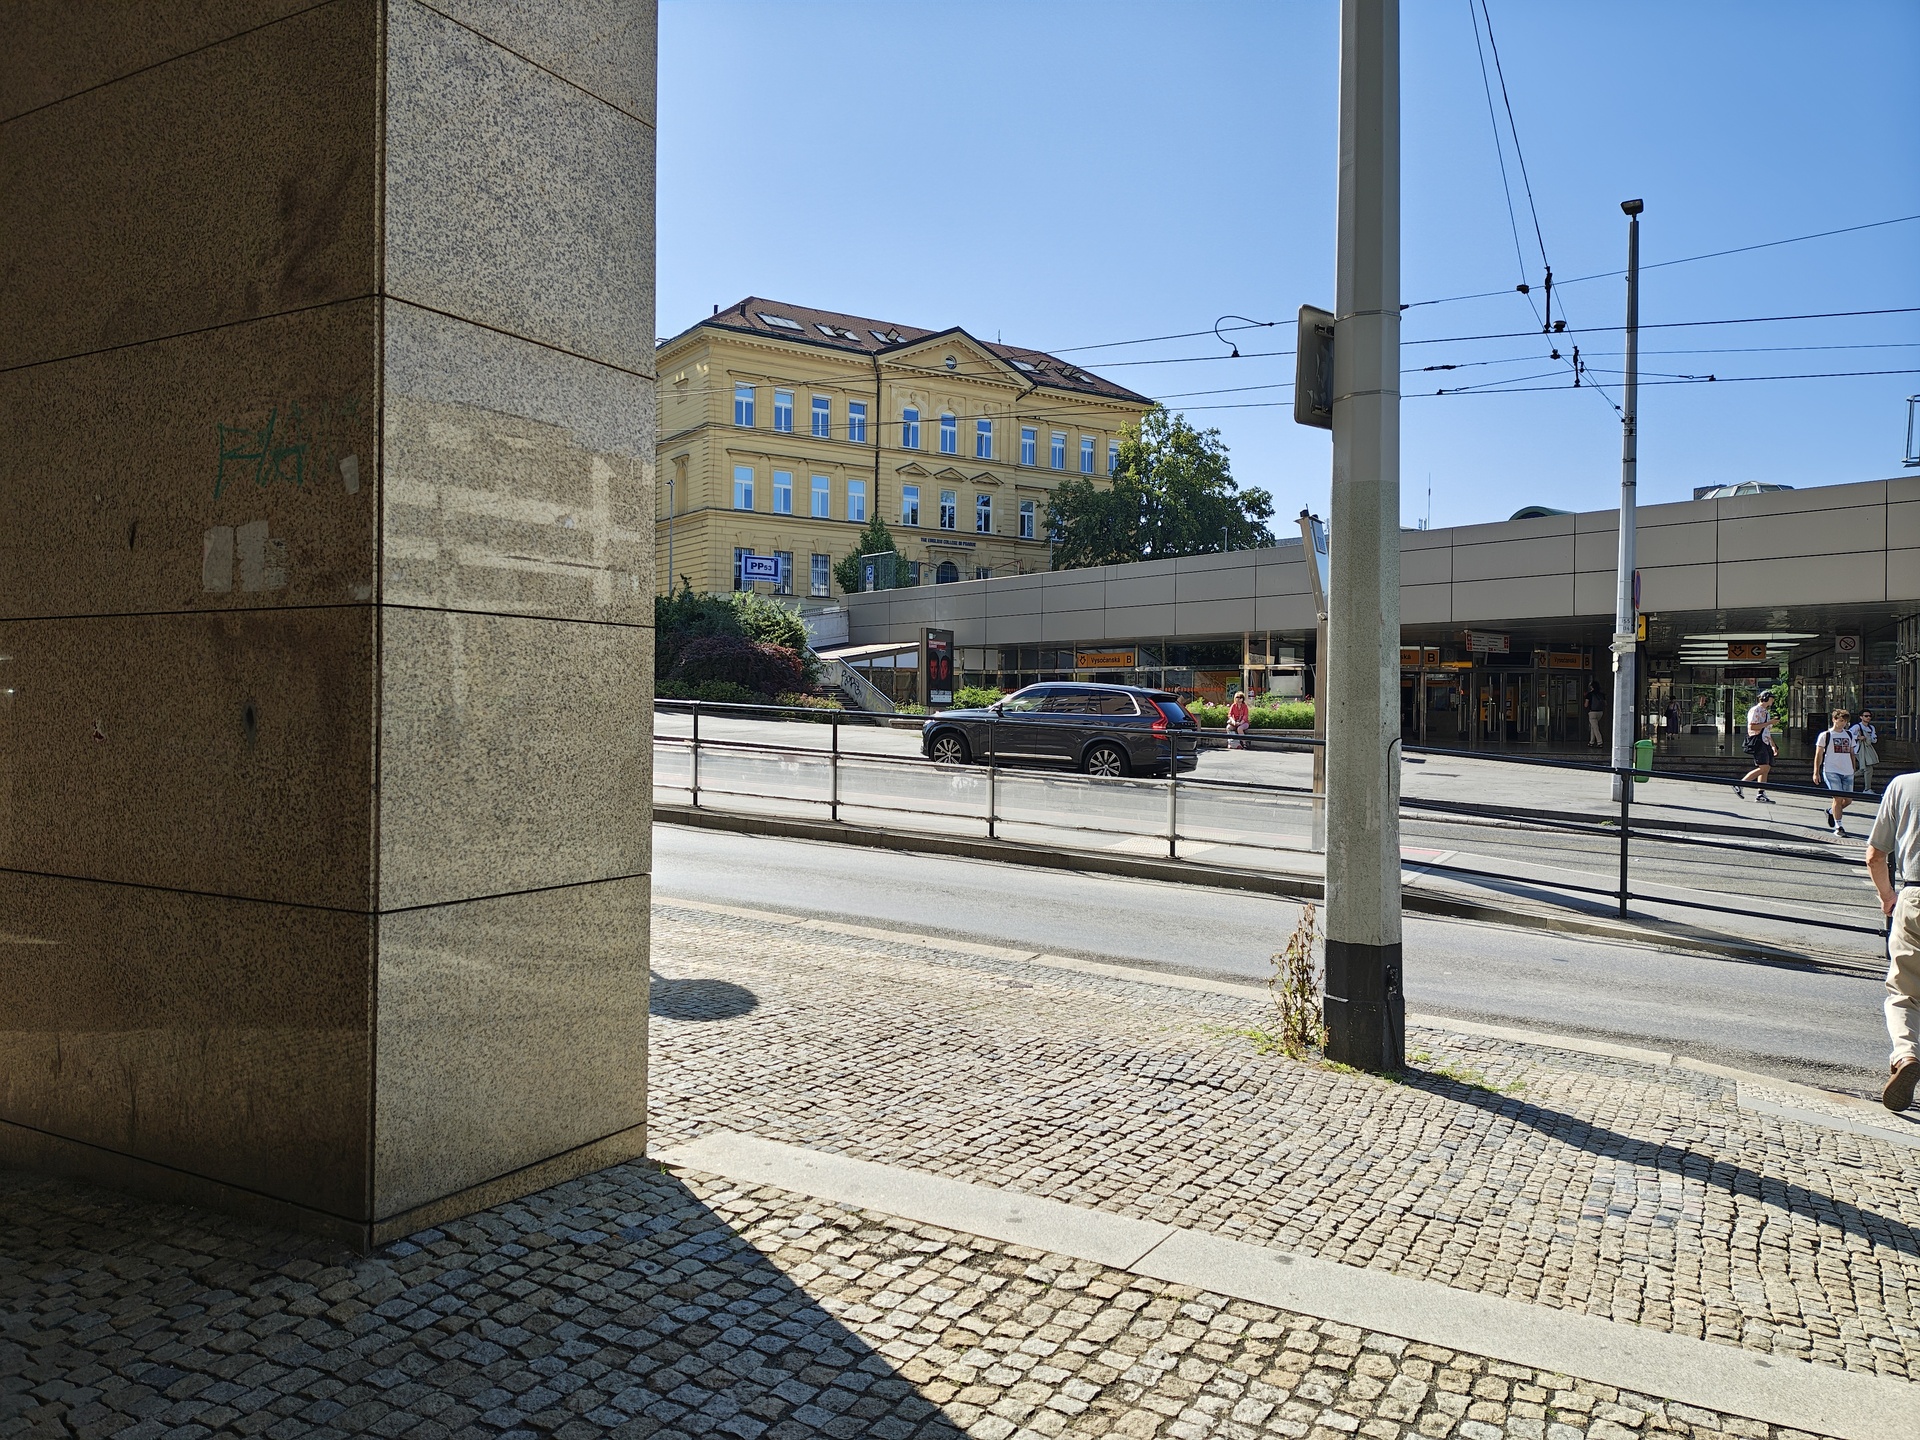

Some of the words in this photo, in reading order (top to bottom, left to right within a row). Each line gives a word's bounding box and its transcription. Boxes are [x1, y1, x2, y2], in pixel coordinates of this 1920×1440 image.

[1091, 655, 1121, 664] Vysočanská
[1126, 655, 1132, 664] B
[1427, 653, 1435, 663] B
